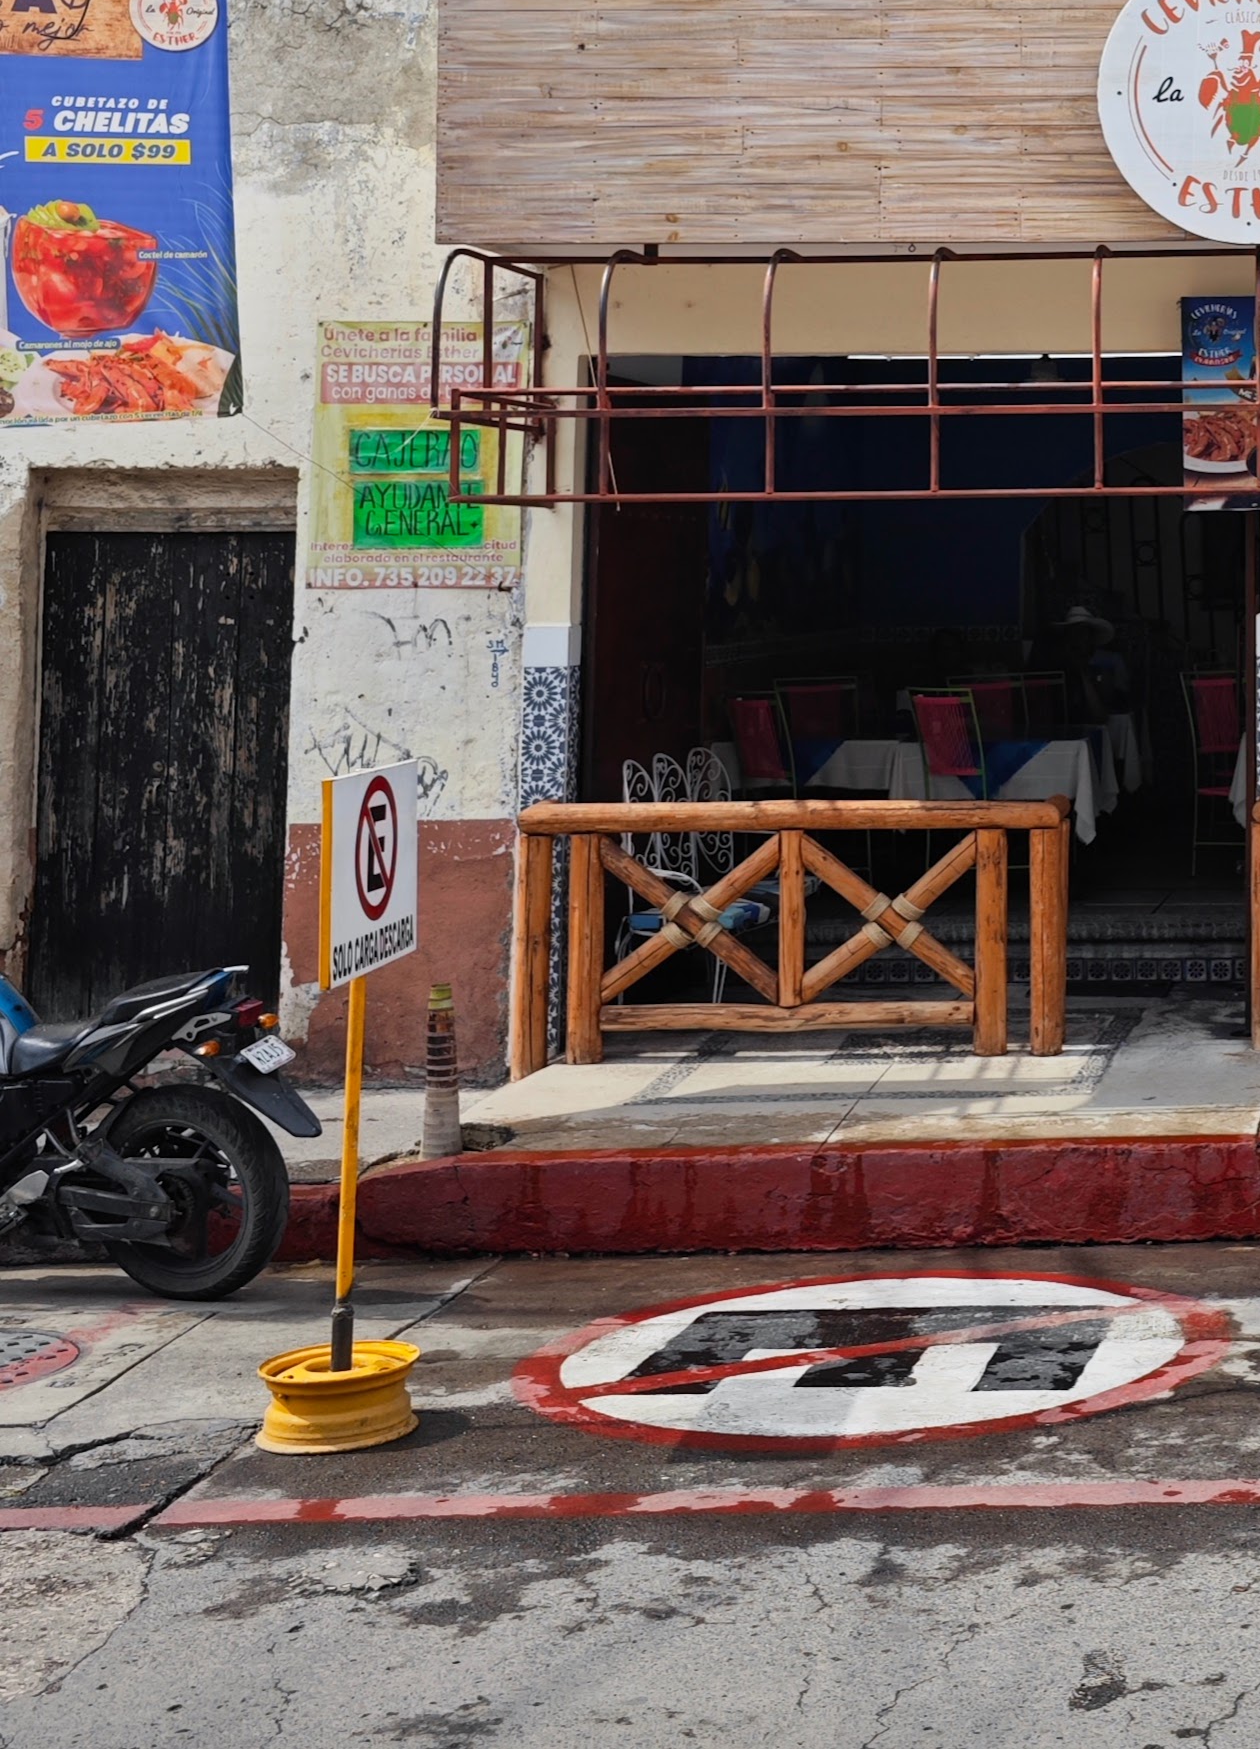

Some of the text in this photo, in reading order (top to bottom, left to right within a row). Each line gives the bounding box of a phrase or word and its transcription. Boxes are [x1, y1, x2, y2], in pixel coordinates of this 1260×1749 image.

[51, 95, 169, 110] CUBETAZO DE
[23, 109, 191, 135] 5 CHELITAS
[41, 142, 176, 160] A SOLO $99
[163, 251, 173, 259] de
[324, 324, 375, 342] Únete
[379, 330, 390, 342] a
[394, 327, 410, 342] la
[19, 341, 62, 349] Camarones
[64, 340, 72, 348] al
[72, 340, 92, 349] mojo
[93, 340, 103, 348] de
[426, 344, 478, 359] Ether
[327, 364, 516, 384] SE BUSCA PRSOAL
[331, 386, 362, 399] con
[365, 386, 416, 403] ganas
[365, 509, 470, 537] GENERAL
[394, 554, 410, 563] en
[428, 553, 504, 563] restaurante
[374, 567, 414, 587] 735
[418, 567, 457, 586] 209
[461, 567, 486, 585] 22
[489, 566, 517, 586] 37
[333, 914, 414, 981] SOLO CARGA DESCARGA
